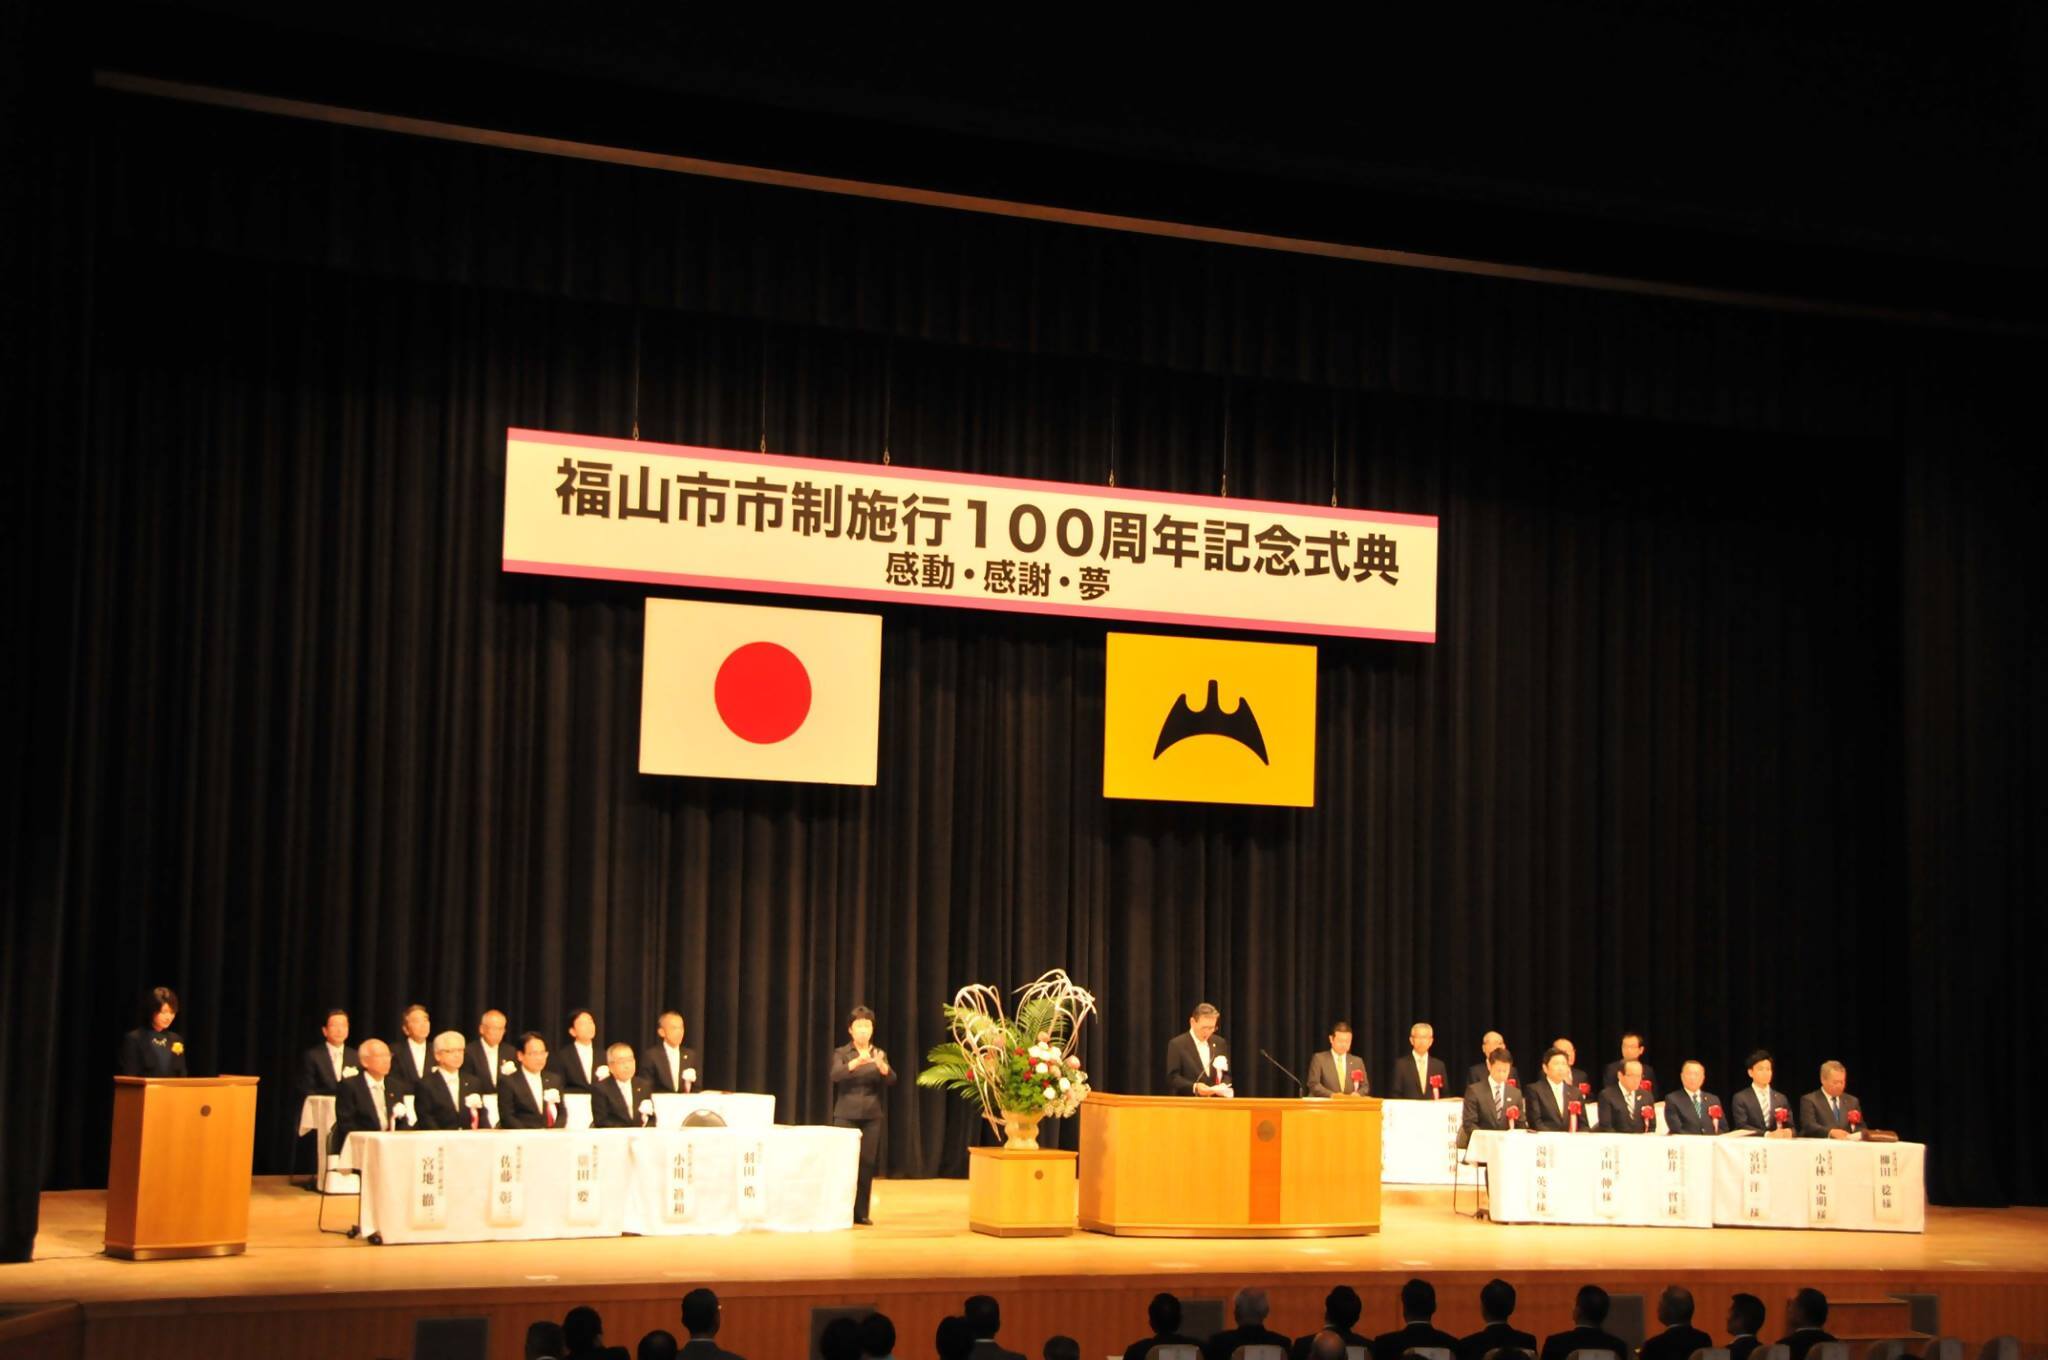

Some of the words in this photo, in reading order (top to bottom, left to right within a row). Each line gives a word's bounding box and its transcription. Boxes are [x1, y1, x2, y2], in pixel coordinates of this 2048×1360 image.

[556, 458, 1400, 586] 福山市市制施行100周年記念式典
[885, 552, 1110, 601] 感動・感謝・夢
